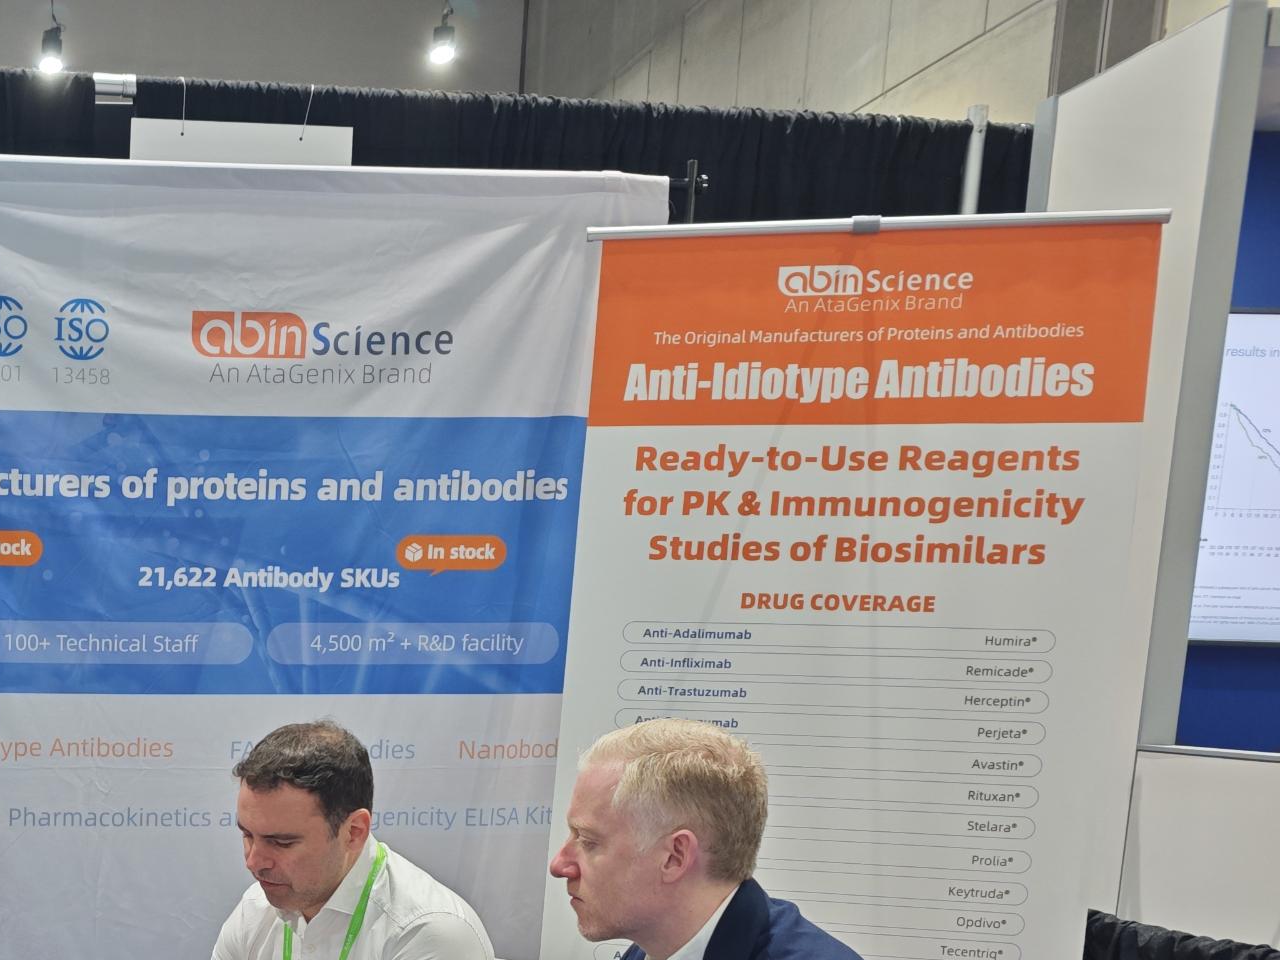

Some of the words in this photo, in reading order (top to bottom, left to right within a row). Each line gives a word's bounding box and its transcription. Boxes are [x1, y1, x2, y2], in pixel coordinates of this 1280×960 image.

[778, 265, 973, 296] abinScience
[785, 297, 808, 313] An
[813, 296, 900, 313] AtaGenix
[905, 294, 963, 311] Brand
[54, 317, 109, 342] ISO
[192, 311, 452, 358] abinScience
[654, 331, 681, 345] The
[685, 329, 746, 347] Original
[750, 327, 862, 344] Manufacturers
[867, 328, 884, 342] of
[888, 325, 954, 342] Proteins
[958, 325, 990, 340] and
[993, 323, 1084, 339] Antibodies
[1225, 347, 1266, 358] results
[52, 368, 109, 385] 13458
[209, 363, 239, 383] An
[247, 363, 354, 384] AtaGenix
[363, 363, 431, 384] Brand
[624, 361, 868, 403] Anti-Idiotype
[875, 357, 1094, 399] Antibodies
[635, 444, 887, 477] Ready-to-Use
[898, 445, 1080, 477] Reagents
[122, 468, 158, 499] of
[167, 469, 306, 506] proteins
[318, 471, 383, 501] and
[394, 469, 567, 501] antibodies
[624, 489, 673, 516] for
[682, 491, 729, 515] PK
[738, 490, 760, 516] &
[770, 489, 1084, 524] Immunogenicity
[428, 544, 444, 559] In
[450, 543, 495, 560] stock
[649, 533, 780, 562] Studies
[790, 535, 827, 562] of
[835, 533, 1045, 565] Biosimilars
[138, 567, 216, 590] 21,622
[224, 566, 333, 592] Antibody
[341, 568, 399, 588] SKUs
[740, 592, 804, 610] DRUG
[810, 593, 935, 613] COVERAGE
[5, 634, 50, 651] 100+
[58, 633, 146, 652] Technical
[153, 634, 198, 652] Staff
[311, 635, 361, 655] 4,500
[401, 639, 411, 648] +
[418, 635, 455, 652] R&D
[462, 633, 524, 655] facility
[643, 628, 751, 641] Anti-Adalimumab
[640, 657, 732, 669] Anti-Infliximab
[638, 684, 747, 699] Anti-Trastuzumab
[50, 738, 174, 759] Antibodies
[8, 807, 210, 828] Pharmacokinetics
[465, 808, 519, 826] ELISA
